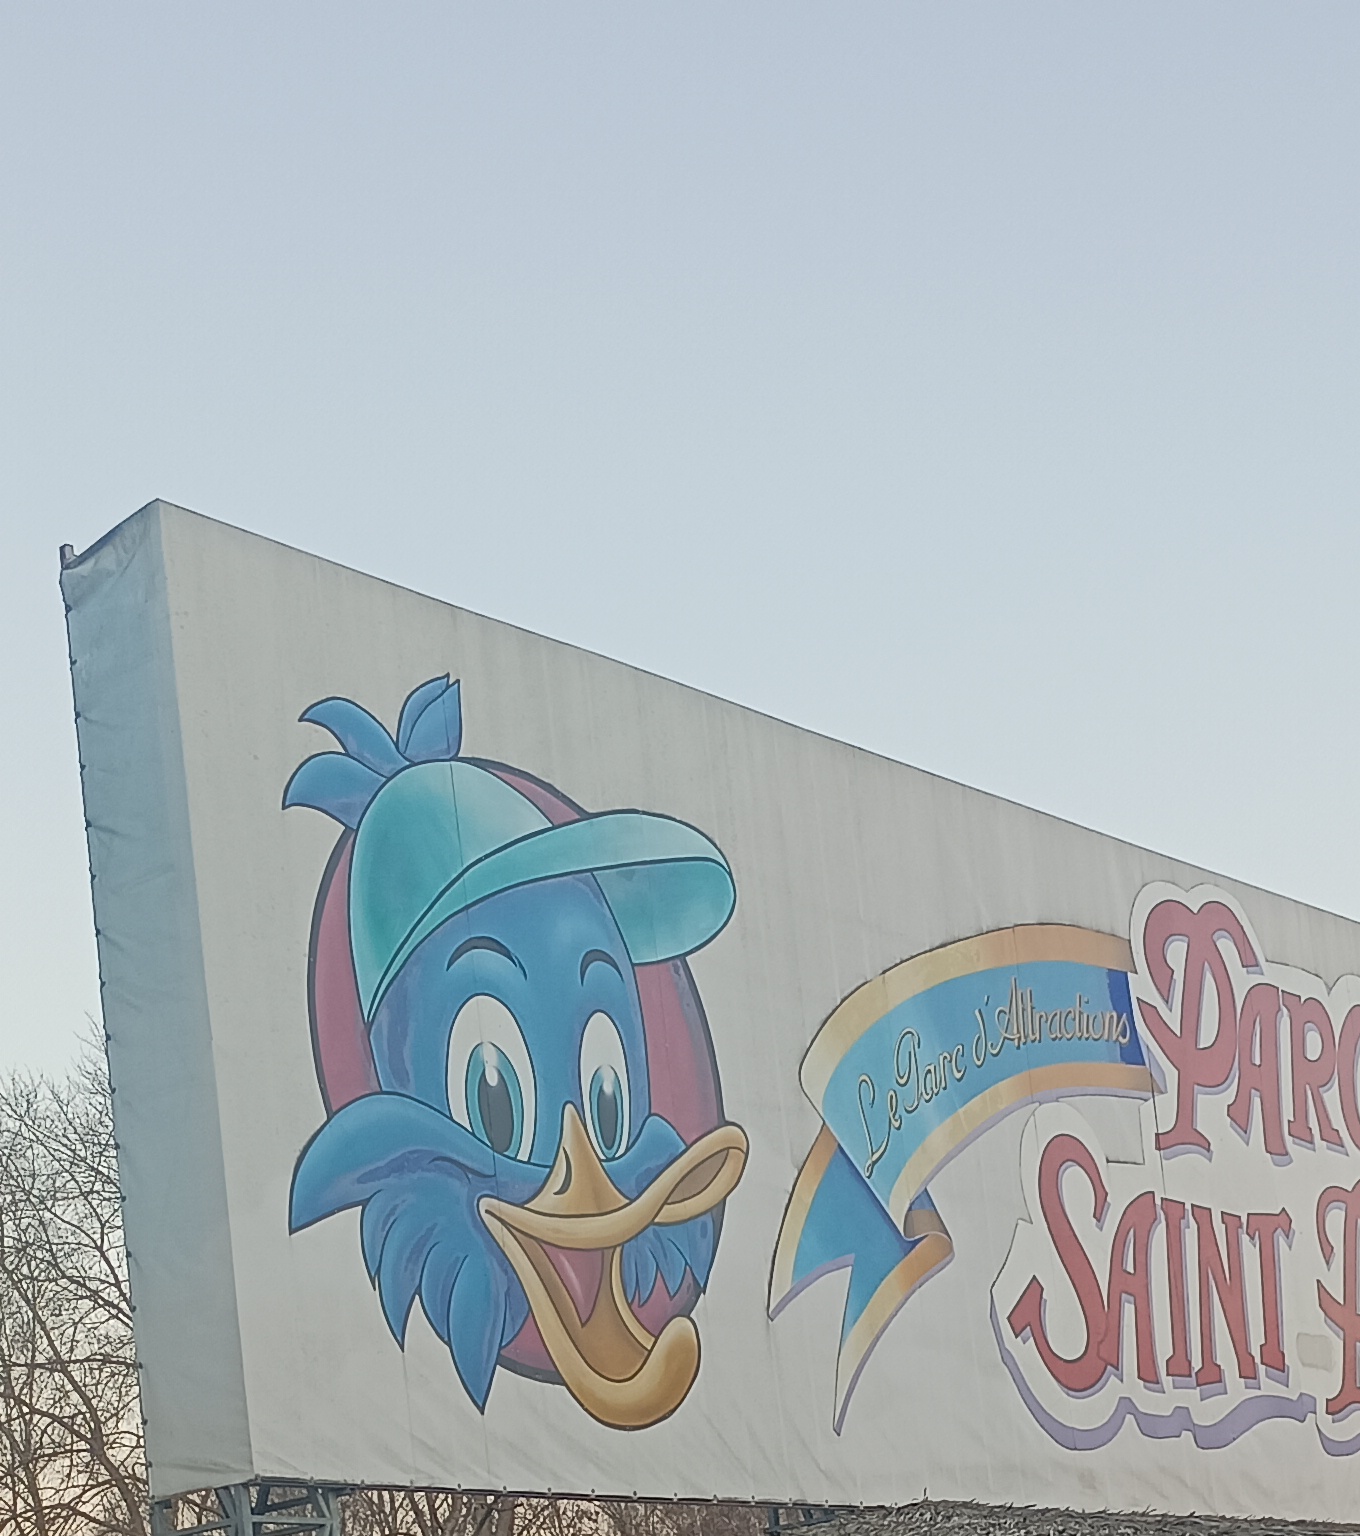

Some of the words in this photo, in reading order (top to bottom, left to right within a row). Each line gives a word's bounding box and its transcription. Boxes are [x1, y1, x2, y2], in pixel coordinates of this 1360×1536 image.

[858, 1073, 902, 1179] Le
[894, 1027, 967, 1112] Parc
[973, 976, 1131, 1067] d'Attractions
[1008, 1132, 1293, 1393] SAINT
